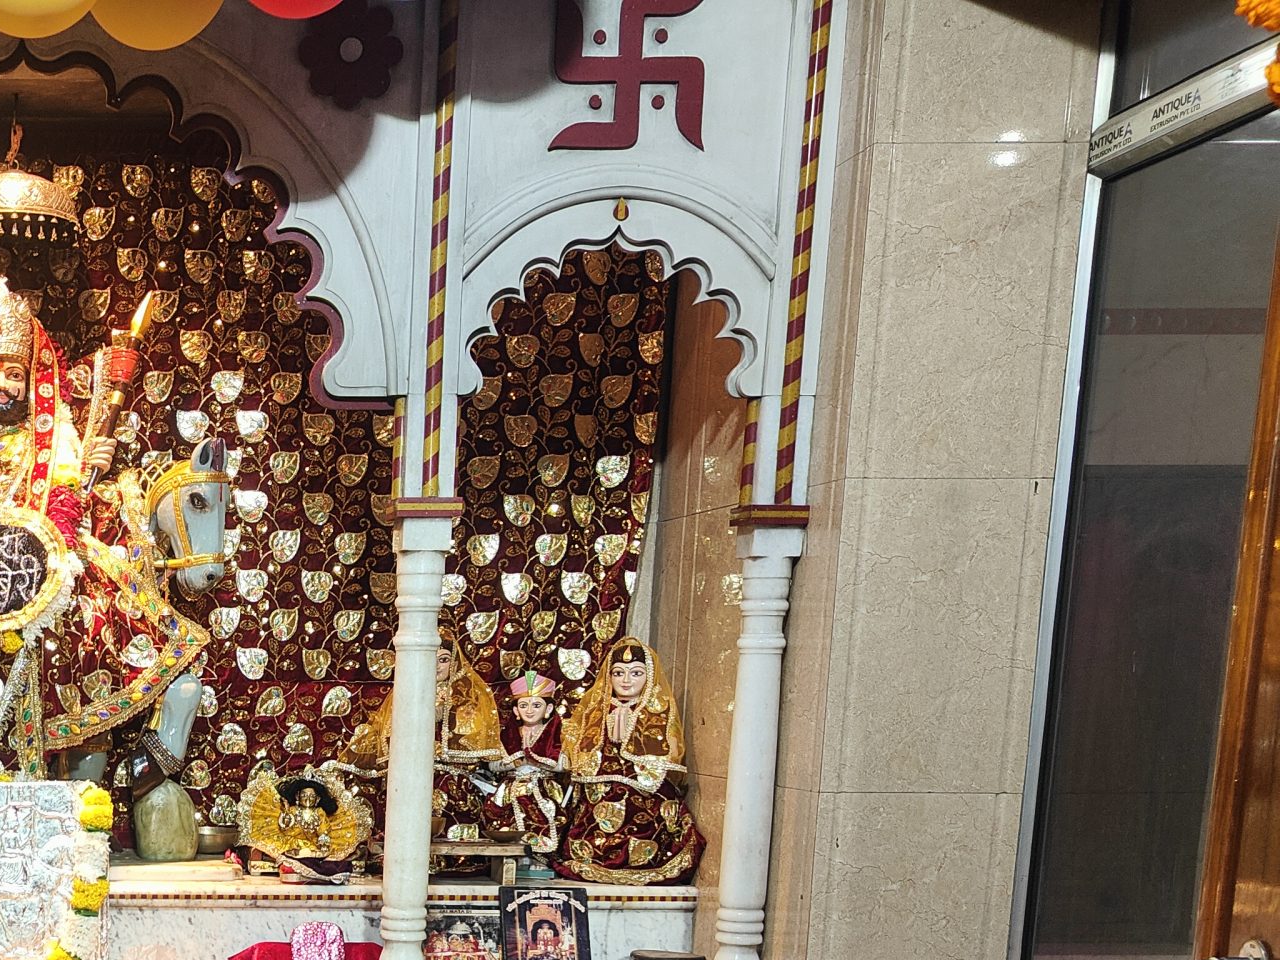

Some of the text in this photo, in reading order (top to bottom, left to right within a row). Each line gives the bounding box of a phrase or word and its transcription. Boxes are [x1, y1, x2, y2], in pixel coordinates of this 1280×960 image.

[1151, 92, 1193, 121] ANTIQUE
[1150, 114, 1179, 133] EXTRUSION
[1089, 126, 1124, 152] ANTIQUE
[1088, 147, 1112, 162] XTRUSION
